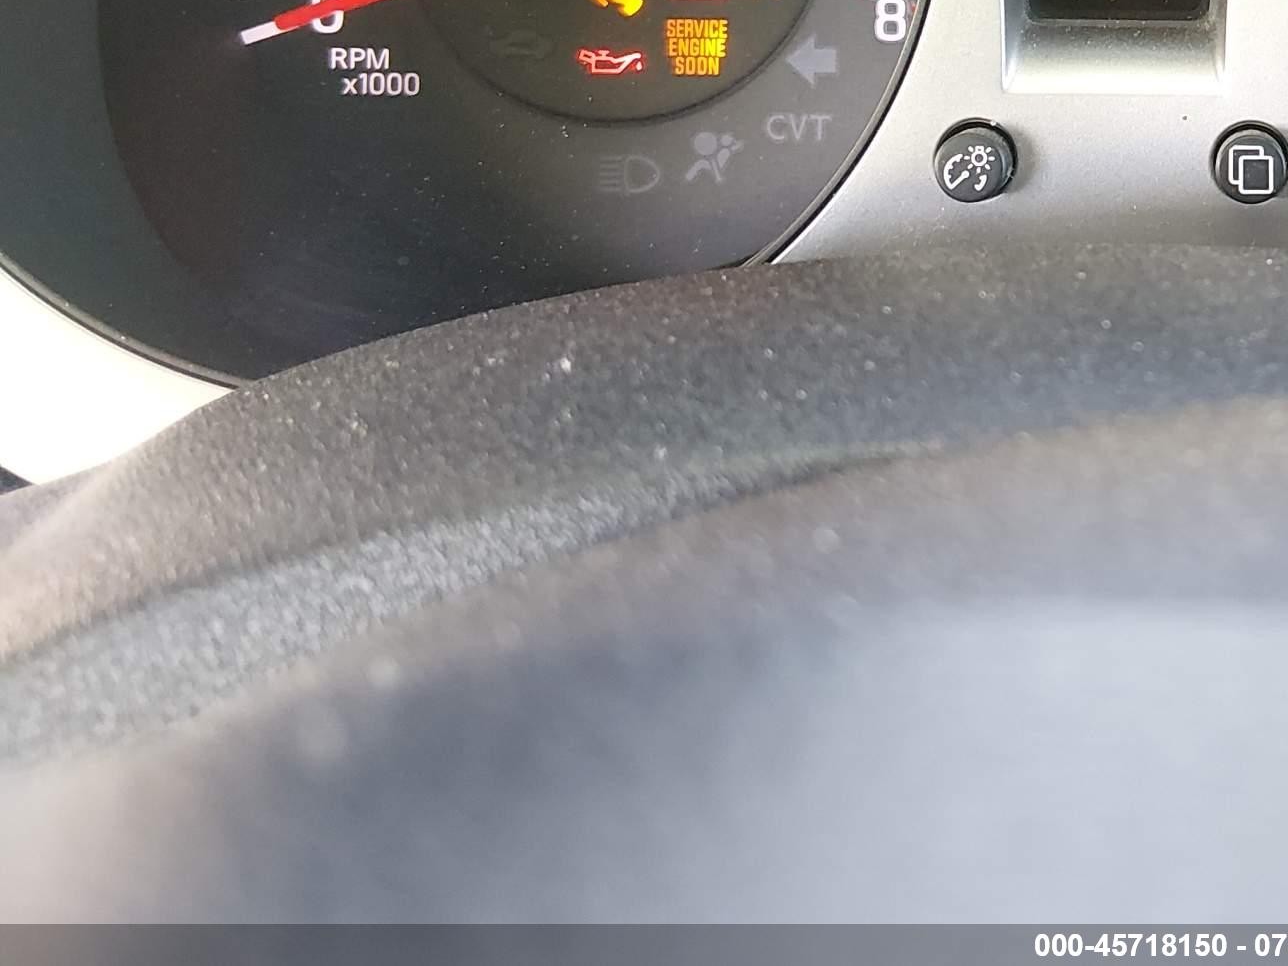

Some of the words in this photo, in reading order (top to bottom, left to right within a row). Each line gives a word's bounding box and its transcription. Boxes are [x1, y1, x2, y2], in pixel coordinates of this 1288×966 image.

[666, 19, 728, 38] SERVICE
[668, 38, 726, 57] ENGINE
[329, 47, 390, 70] RPM
[674, 56, 720, 76] SOON
[343, 72, 421, 96] x1000
[766, 114, 833, 141] CVT
